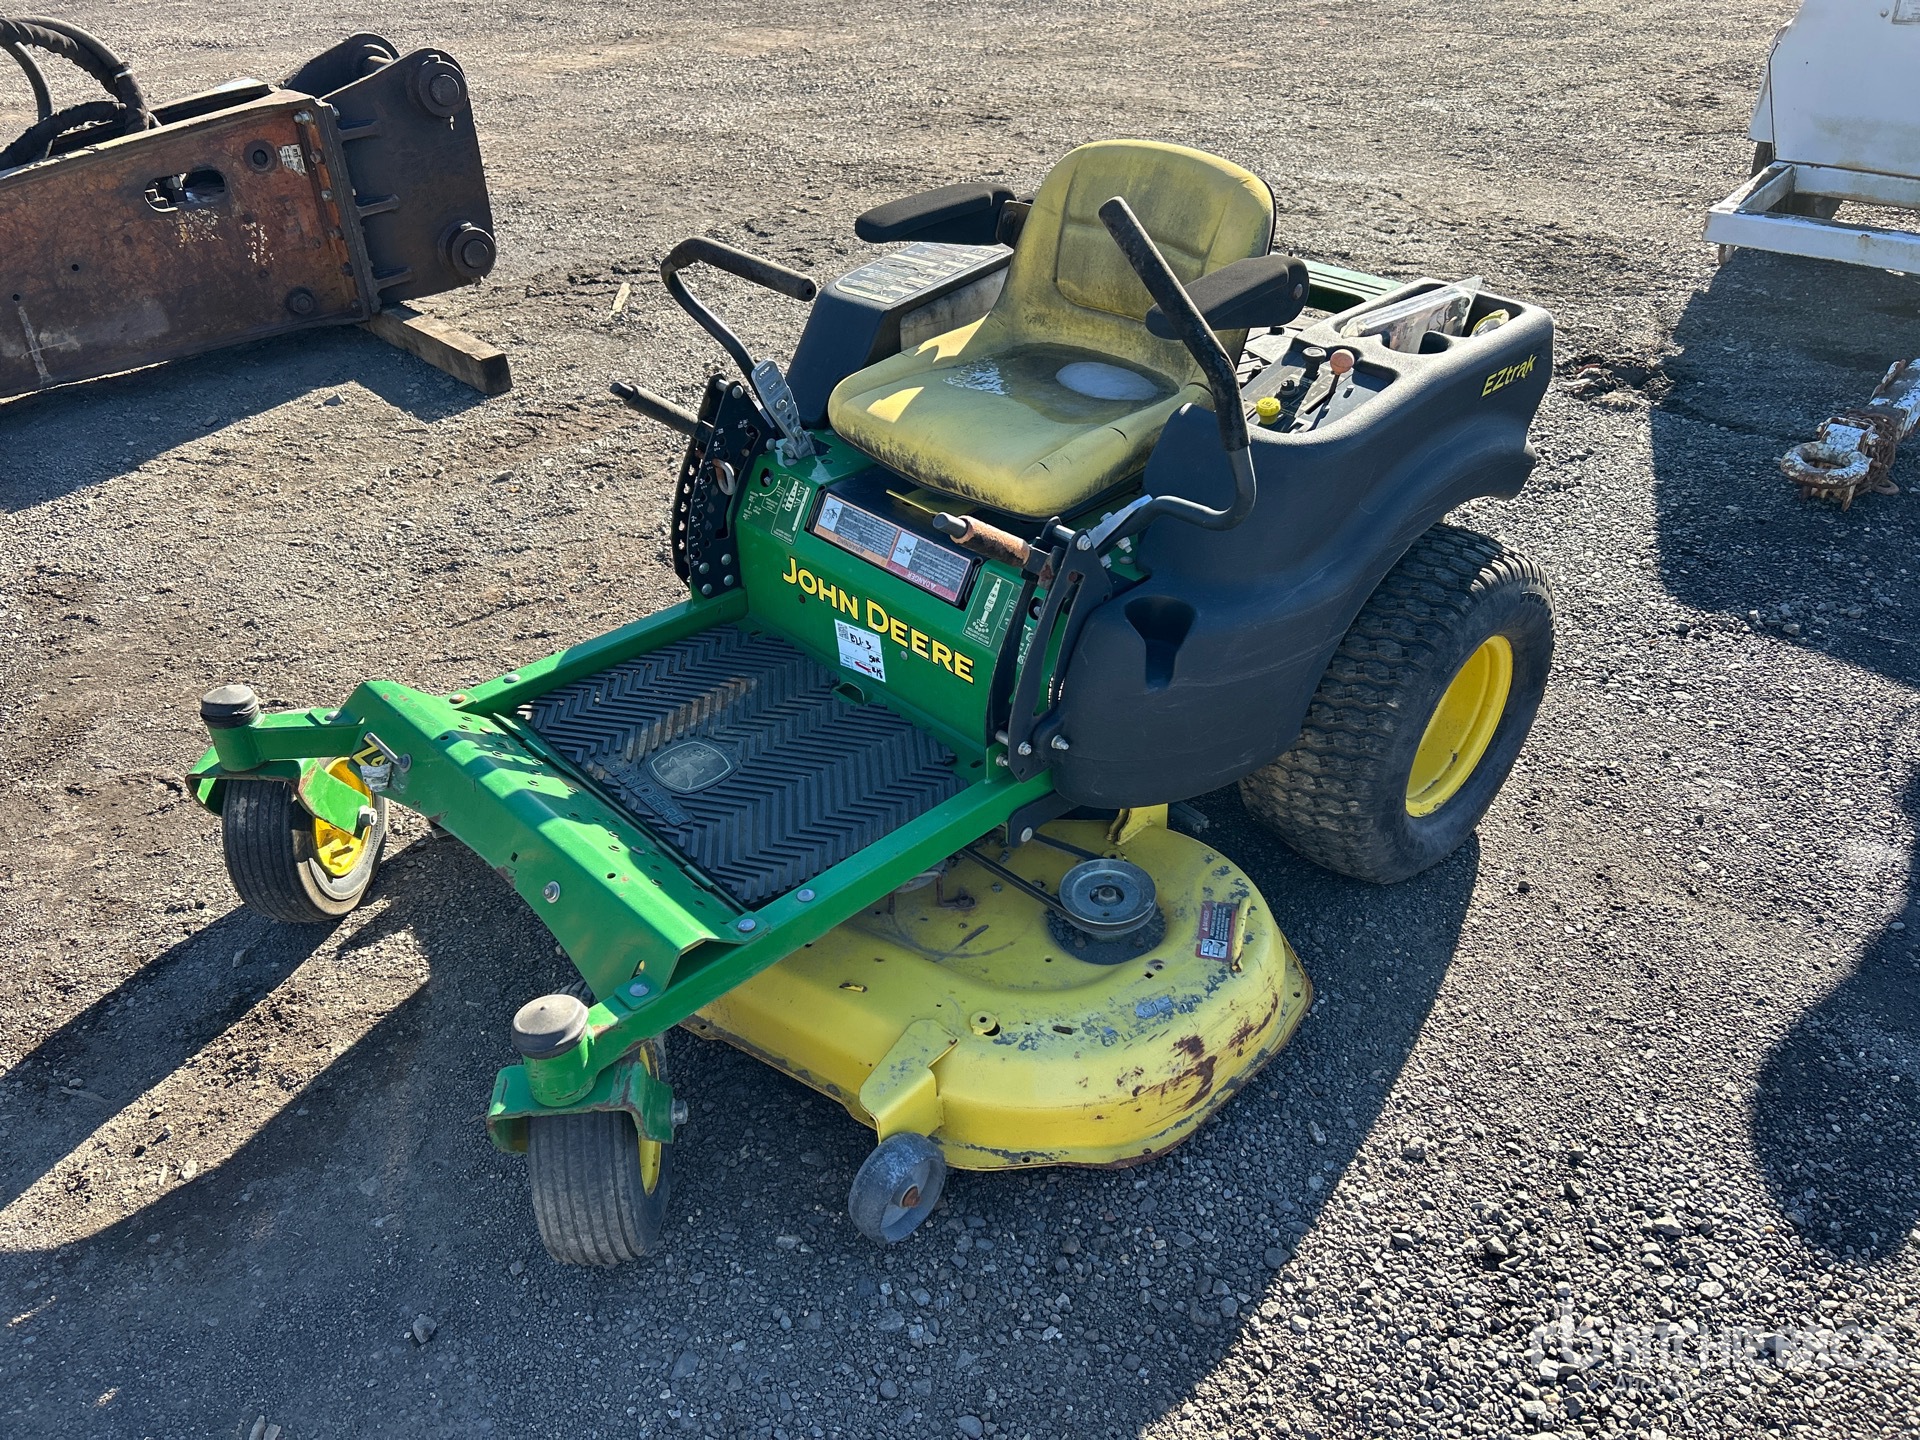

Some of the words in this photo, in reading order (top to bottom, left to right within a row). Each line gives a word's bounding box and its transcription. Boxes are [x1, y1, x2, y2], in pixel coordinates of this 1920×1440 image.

[1481, 354, 1537, 397] EZtrak
[907, 571, 933, 589] DANGER
[783, 556, 859, 620] JOHN
[866, 598, 975, 685] DEERE
[631, 781, 690, 826] DEERE
